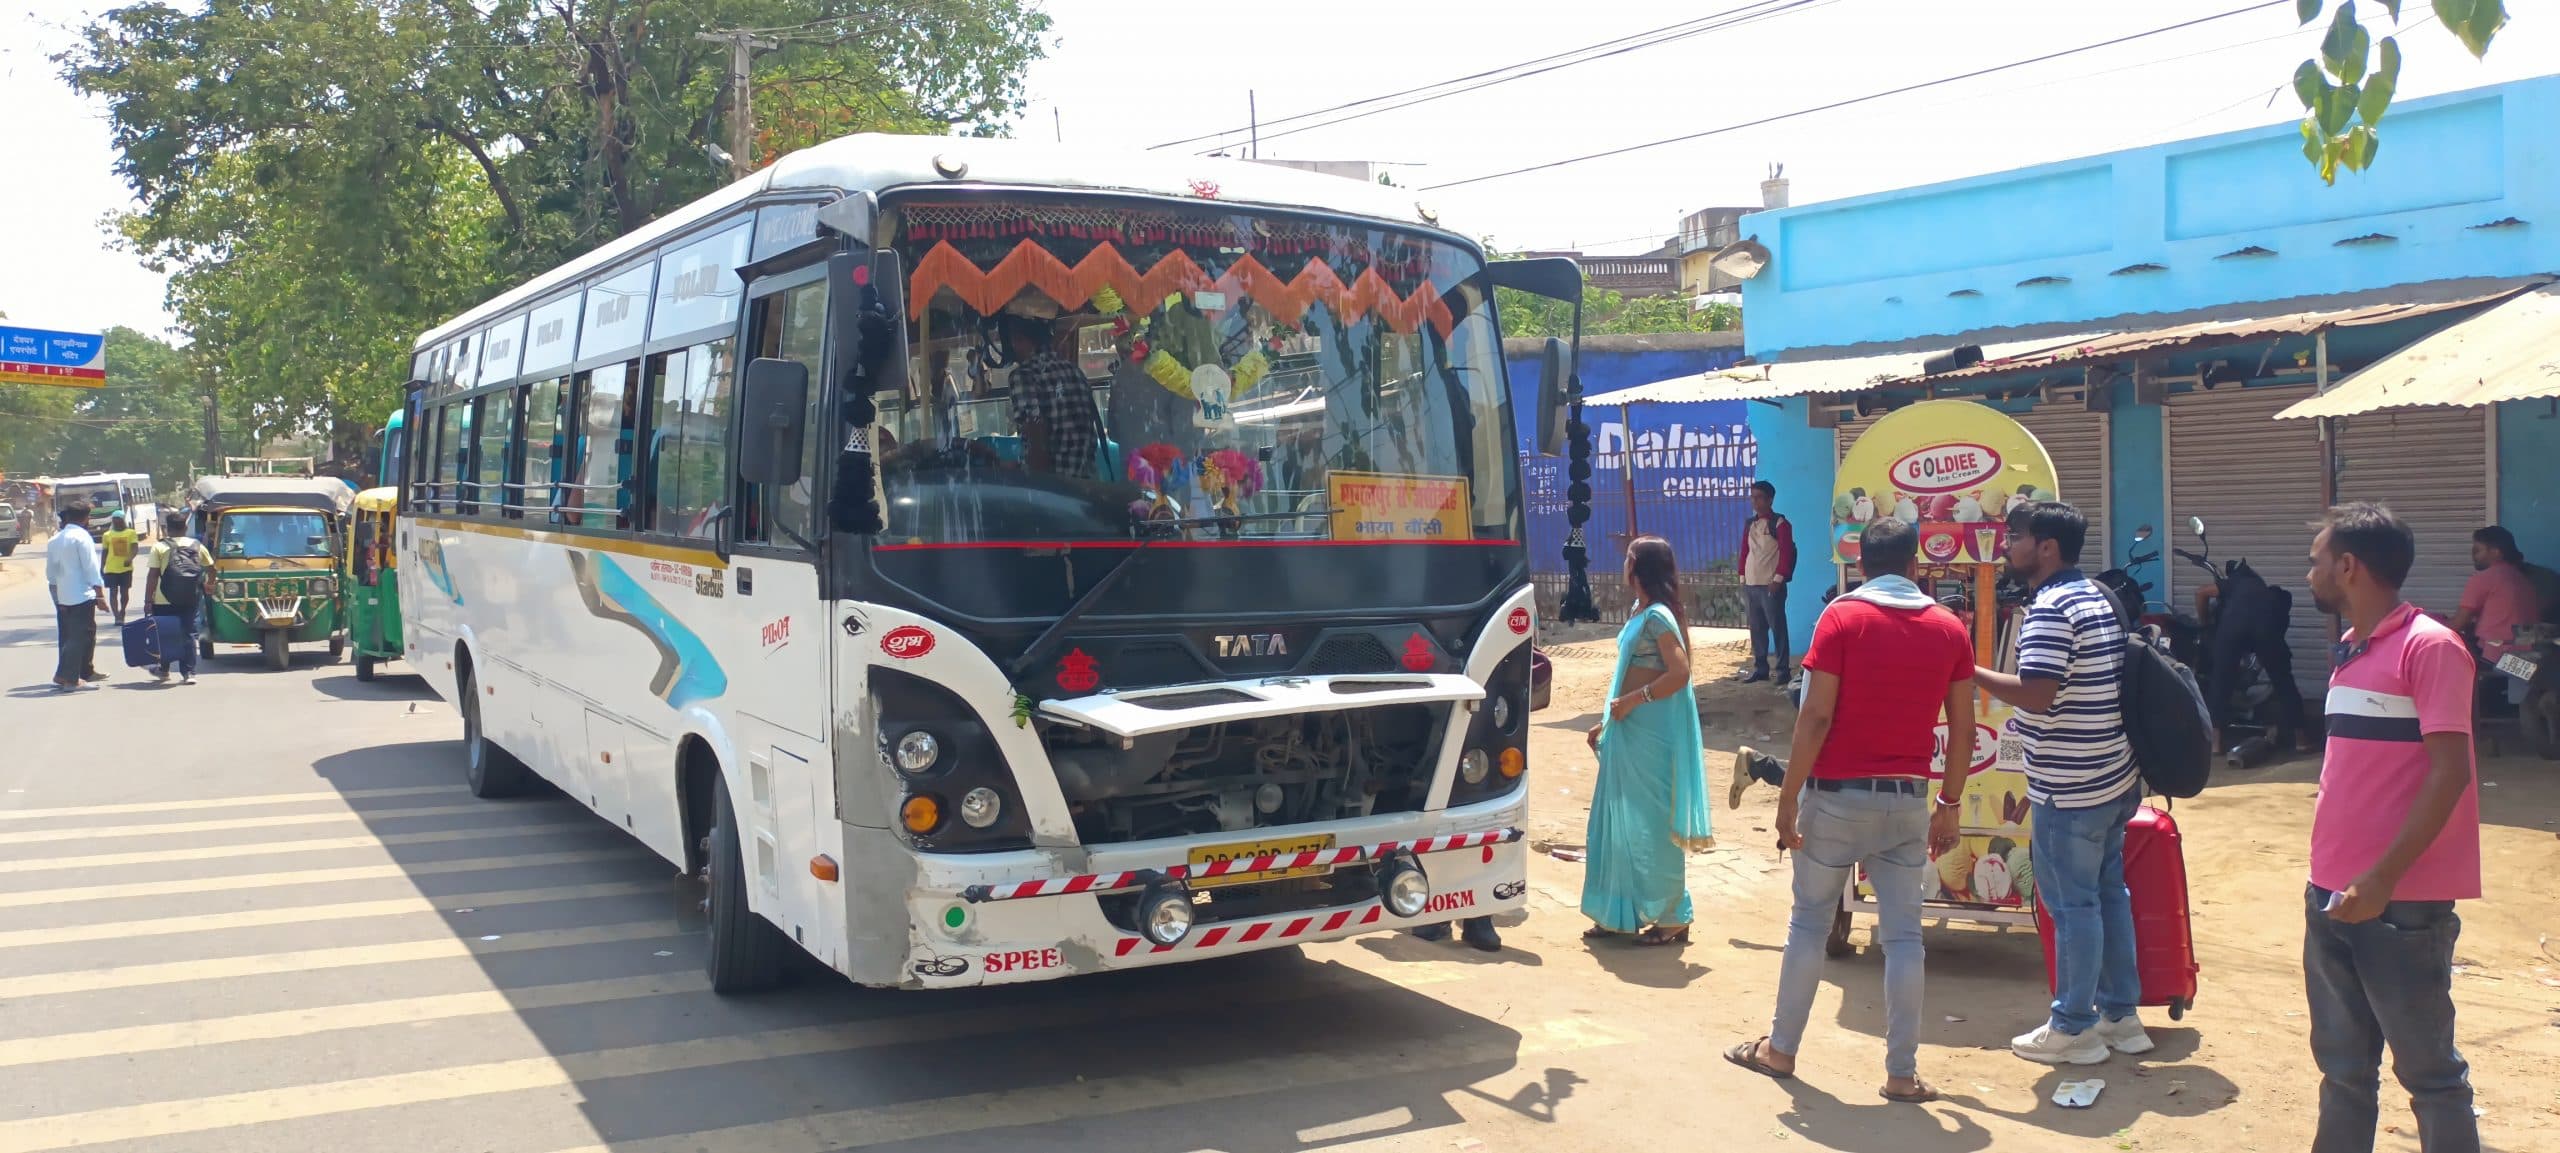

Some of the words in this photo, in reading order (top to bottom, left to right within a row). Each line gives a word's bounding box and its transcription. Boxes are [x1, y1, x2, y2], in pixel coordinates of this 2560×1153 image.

[1908, 452, 1978, 479] GOLDIEE
[1951, 469, 1981, 479] Cream
[1663, 476, 1755, 498] cemen
[696, 573, 724, 598] Starbus
[1214, 633, 1288, 657] TATA
[984, 948, 1065, 973] SPEE
